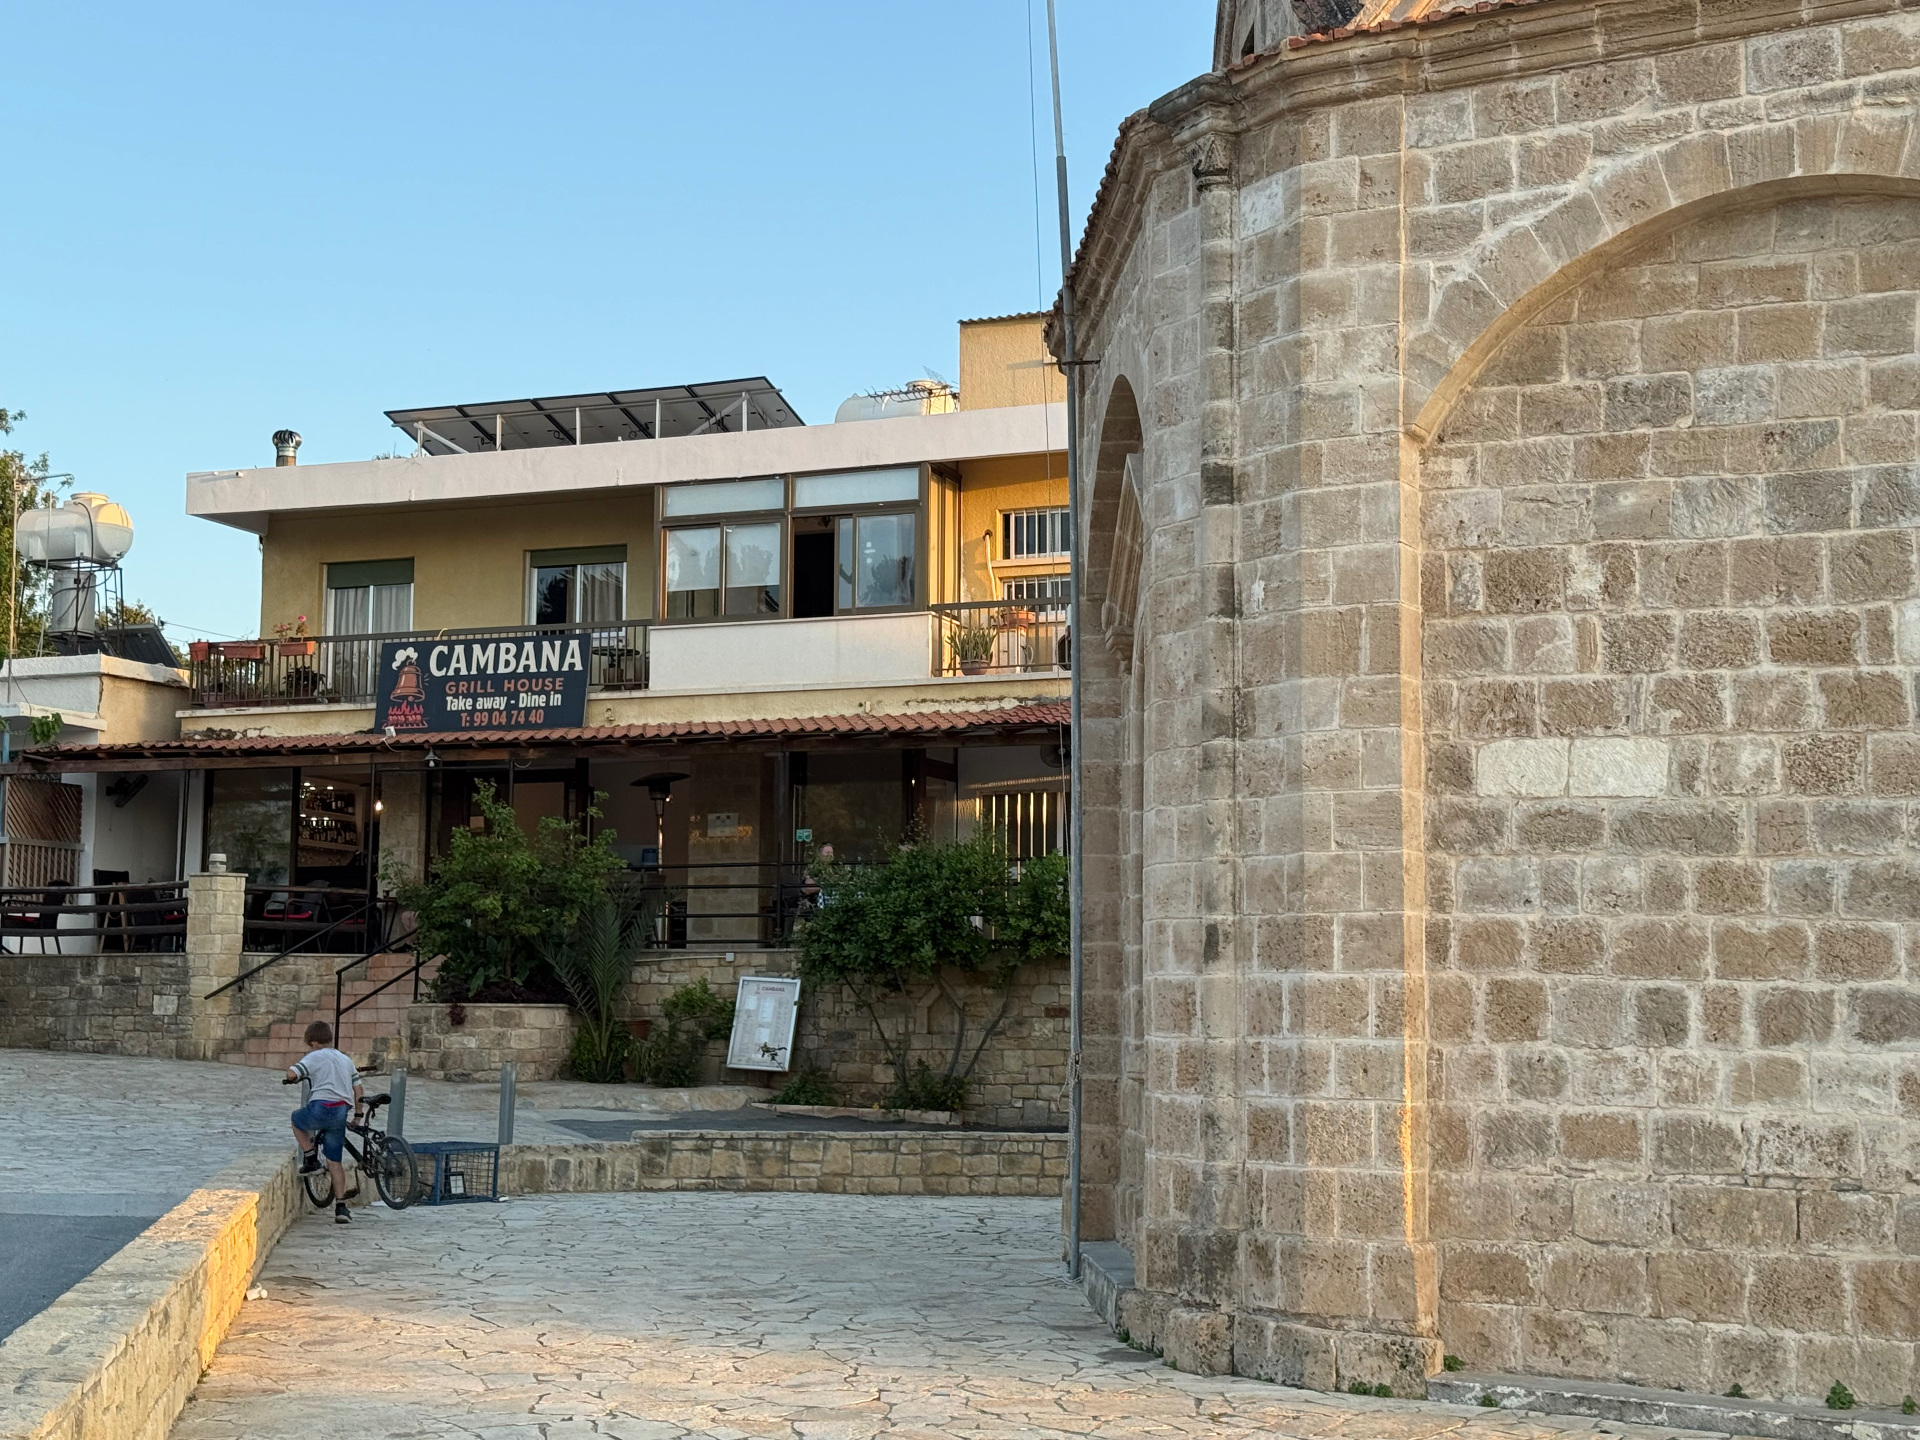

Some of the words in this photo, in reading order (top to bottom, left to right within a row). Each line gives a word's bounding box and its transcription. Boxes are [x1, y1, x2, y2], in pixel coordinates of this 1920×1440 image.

[429, 639, 584, 677] CAMBANA
[445, 680, 495, 694] GRILL
[504, 677, 565, 692] HOUSE
[445, 695, 473, 711] Take
[476, 696, 508, 711] away
[518, 692, 546, 707] Dine
[549, 690, 562, 706] in
[460, 712, 470, 727] T:
[473, 711, 489, 726] 99
[491, 710, 507, 725] 04
[511, 710, 525, 724] 74
[528, 709, 545, 724] 40
